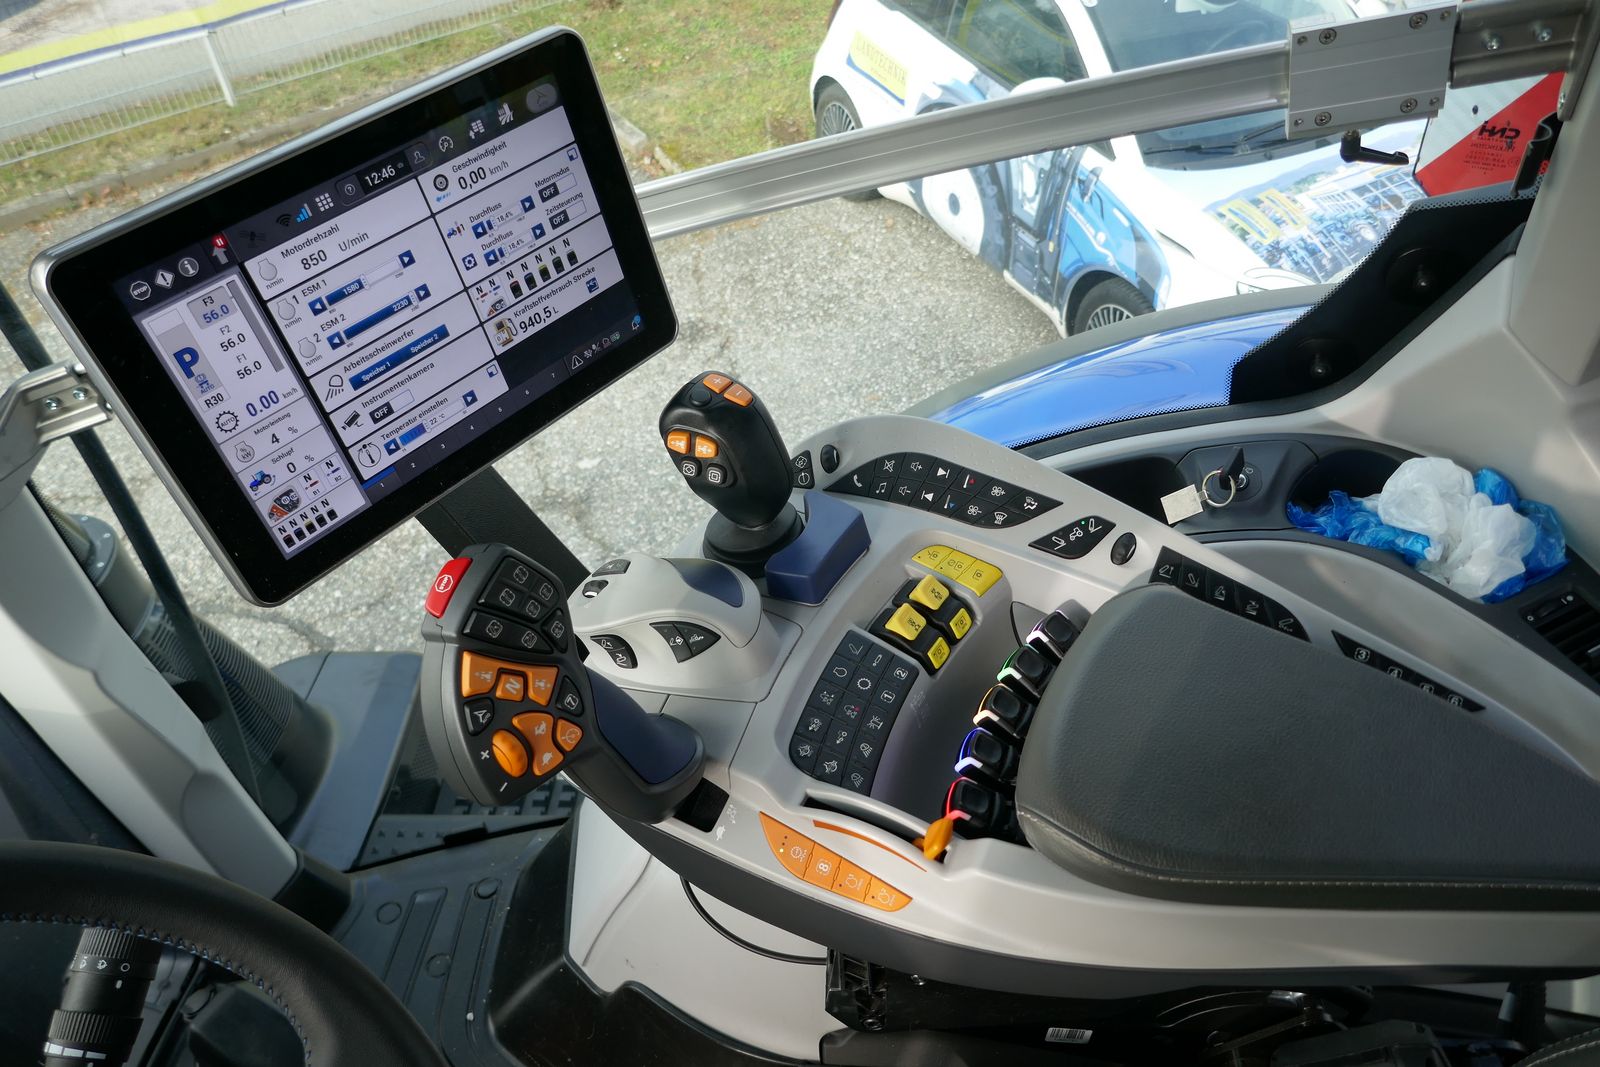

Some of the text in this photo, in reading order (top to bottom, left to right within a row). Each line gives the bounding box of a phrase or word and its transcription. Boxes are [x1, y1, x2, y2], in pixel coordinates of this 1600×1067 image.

[451, 140, 507, 173] Geschwindigkeit
[364, 164, 396, 186] 12:46
[457, 160, 509, 190] 0,00 km/h
[534, 166, 570, 188] Motormodus
[542, 185, 555, 198] OFF
[468, 202, 502, 223] Durchfluss
[545, 191, 584, 216] Zeitsteuerung
[496, 210, 513, 223] 18,4%
[552, 213, 565, 225] OFF
[280, 223, 340, 258] Motordrehzahl
[480, 230, 514, 251] Durchfluss
[507, 238, 525, 250] 18,4%
[300, 232, 369, 270] 850 U/min
[505, 269, 514, 280] N
[520, 261, 529, 272] N
[534, 253, 543, 264] N
[548, 245, 557, 256] N
[562, 237, 571, 248] N
[132, 285, 148, 296] STOP
[300, 278, 327, 297] ESM 1
[342, 282, 360, 295] 1580
[475, 285, 484, 295] N
[488, 278, 496, 288] N
[513, 266, 595, 318] Kraftstoffverbrauch Strecke
[201, 295, 215, 307] F3
[291, 294, 300, 305] 1
[392, 298, 409, 312] 2230
[202, 304, 229, 324] 56.0
[319, 313, 346, 332] ESM 2
[518, 305, 552, 333] 940,5
[219, 324, 232, 336] F2
[312, 332, 322, 343] 2
[219, 332, 246, 352] 56.0
[343, 329, 414, 373] Arbeitsscheinwerfer
[409, 336, 434, 353] Speicher
[173, 346, 199, 379] P
[235, 352, 247, 364] F1
[236, 360, 262, 380] 56.0
[361, 364, 386, 382] Speicher
[361, 362, 435, 408] Instrumentenkamera
[204, 392, 224, 409] R30
[245, 387, 298, 417] 0.00 km/h
[373, 405, 388, 419] OFF
[380, 397, 448, 440] Temperatur einstellen
[428, 416, 438, 426] 22
[220, 416, 236, 427] AUTO
[253, 412, 291, 435] Motorleistung
[271, 425, 299, 444] 4 %
[270, 447, 294, 465] Schlupf
[286, 454, 315, 474] 0 %
[324, 459, 334, 469] N
[302, 472, 312, 483] N
[277, 498, 330, 535] N N N N N
[438, 576, 450, 592] STOP
[1358, 650, 1366, 659] 3
[896, 669, 907, 678] 2
[818, 862, 829, 872] 8
